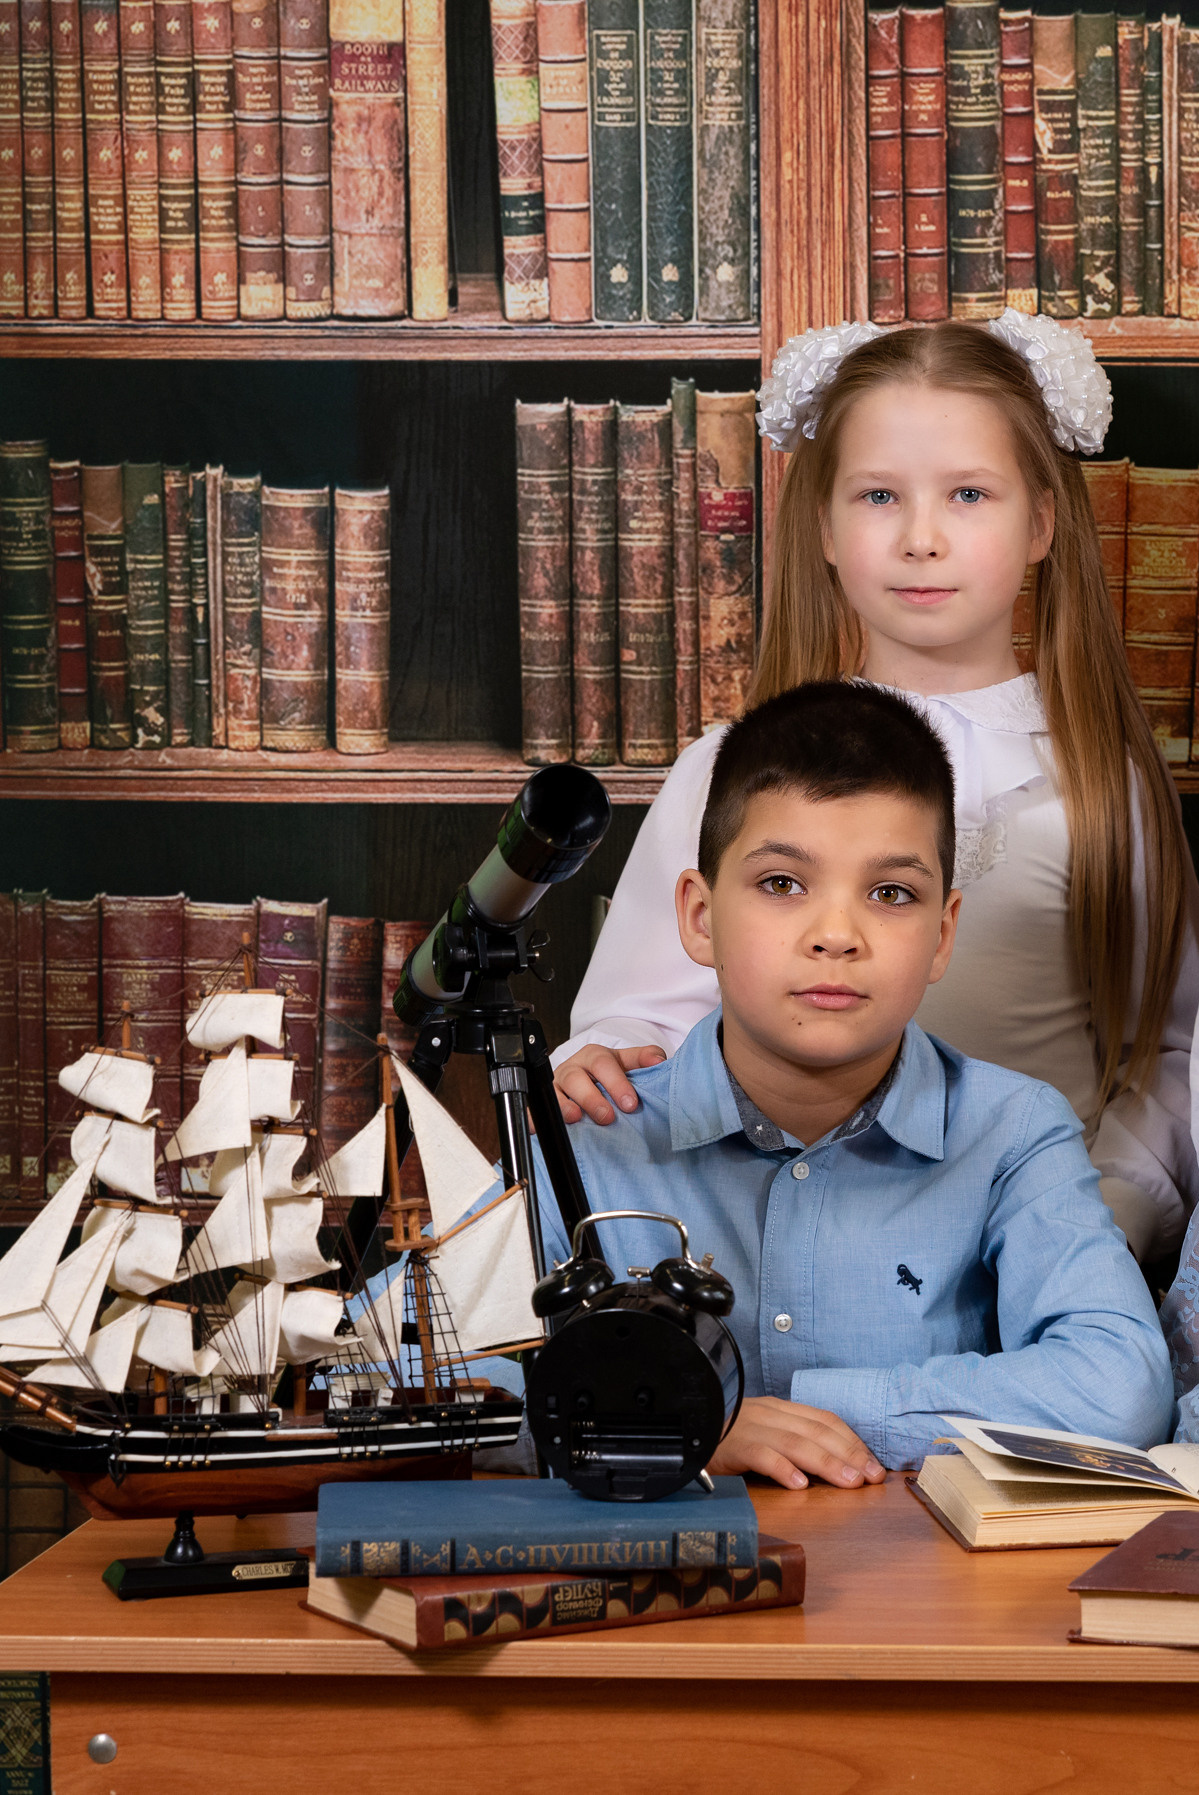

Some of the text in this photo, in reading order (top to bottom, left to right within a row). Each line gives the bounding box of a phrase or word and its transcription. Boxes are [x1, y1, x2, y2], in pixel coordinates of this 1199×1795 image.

[344, 43, 388, 55] BOOTH
[340, 62, 392, 76] STREET
[334, 78, 398, 92] RAILWAYS
[526, 1541, 669, 1572] ПУШКИН
[242, 1565, 275, 1577] CHARLES
[554, 1582, 602, 1602] КУПЕР
